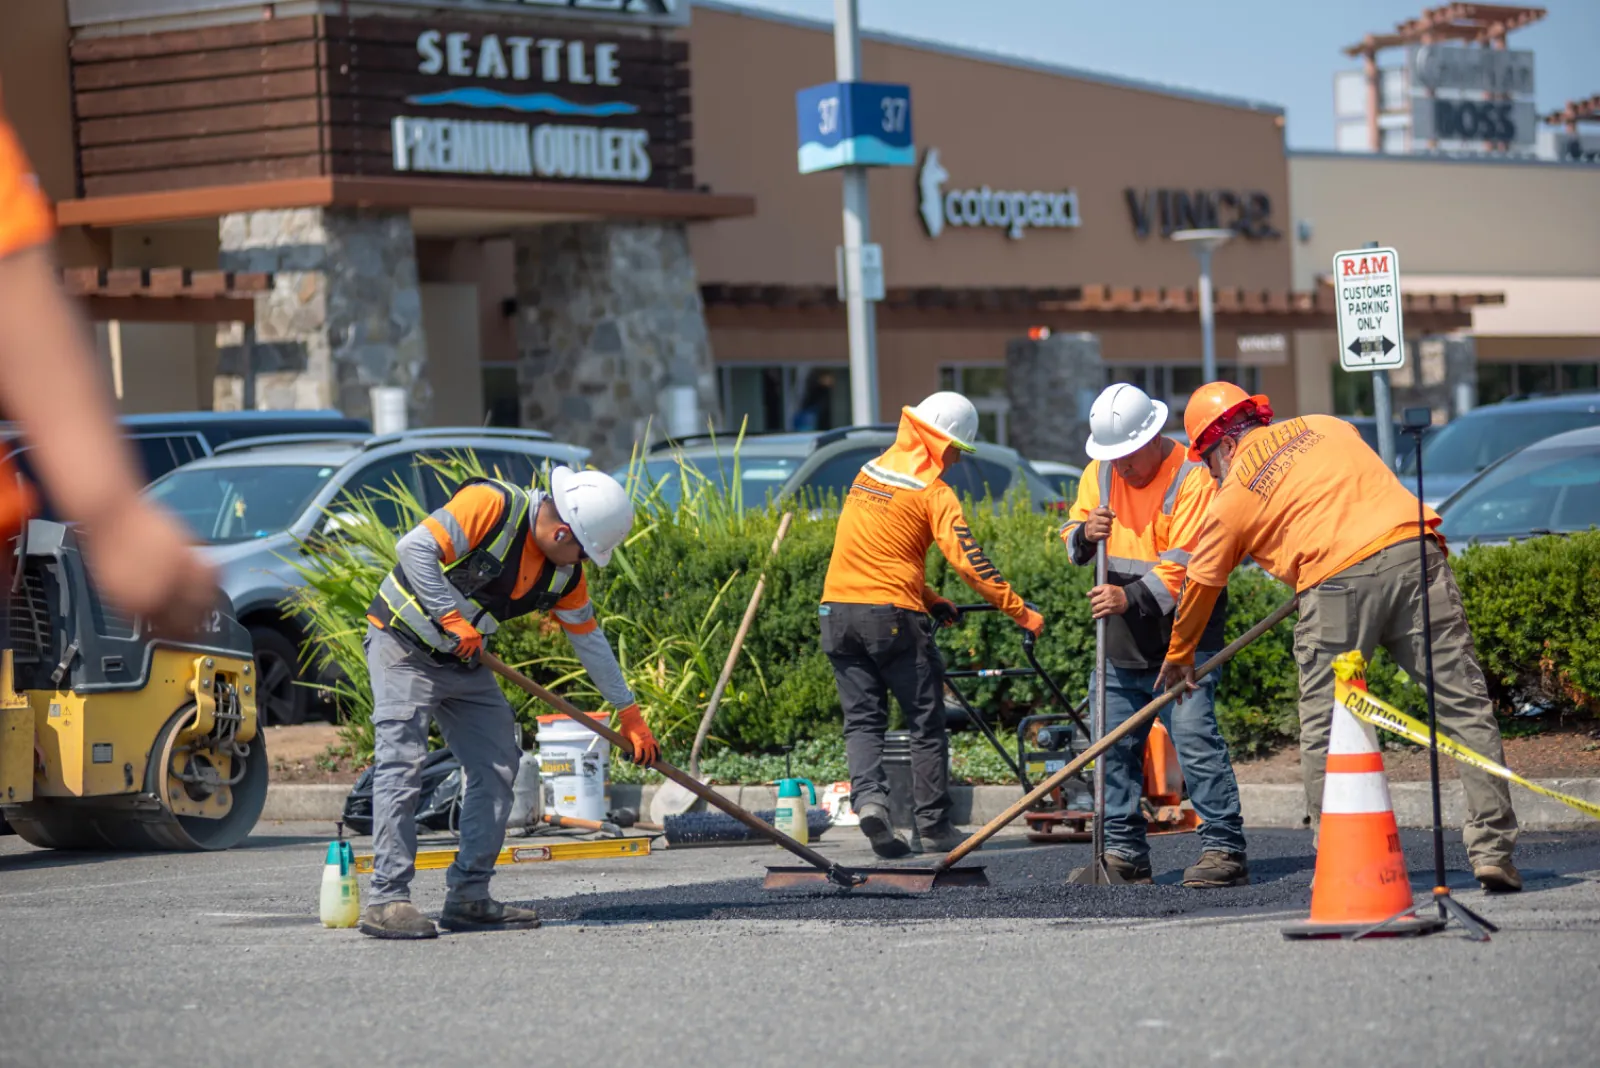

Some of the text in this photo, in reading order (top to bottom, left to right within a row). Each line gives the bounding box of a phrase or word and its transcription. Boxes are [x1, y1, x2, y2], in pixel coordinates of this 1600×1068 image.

[416, 30, 621, 86] SEATTLE
[818, 97, 839, 135] 37
[880, 96, 907, 133] 37
[391, 115, 651, 182] PREMIUM OUTLETS
[945, 185, 1082, 239] cotopaxi
[1342, 256, 1389, 276] RAM
[1343, 284, 1392, 300] CUSTOMER
[1348, 301, 1390, 315] PARKING
[1357, 316, 1382, 331] ONLY
[1255, 462, 1280, 495] ASPHALT
[1344, 692, 1410, 735] CAUTION
